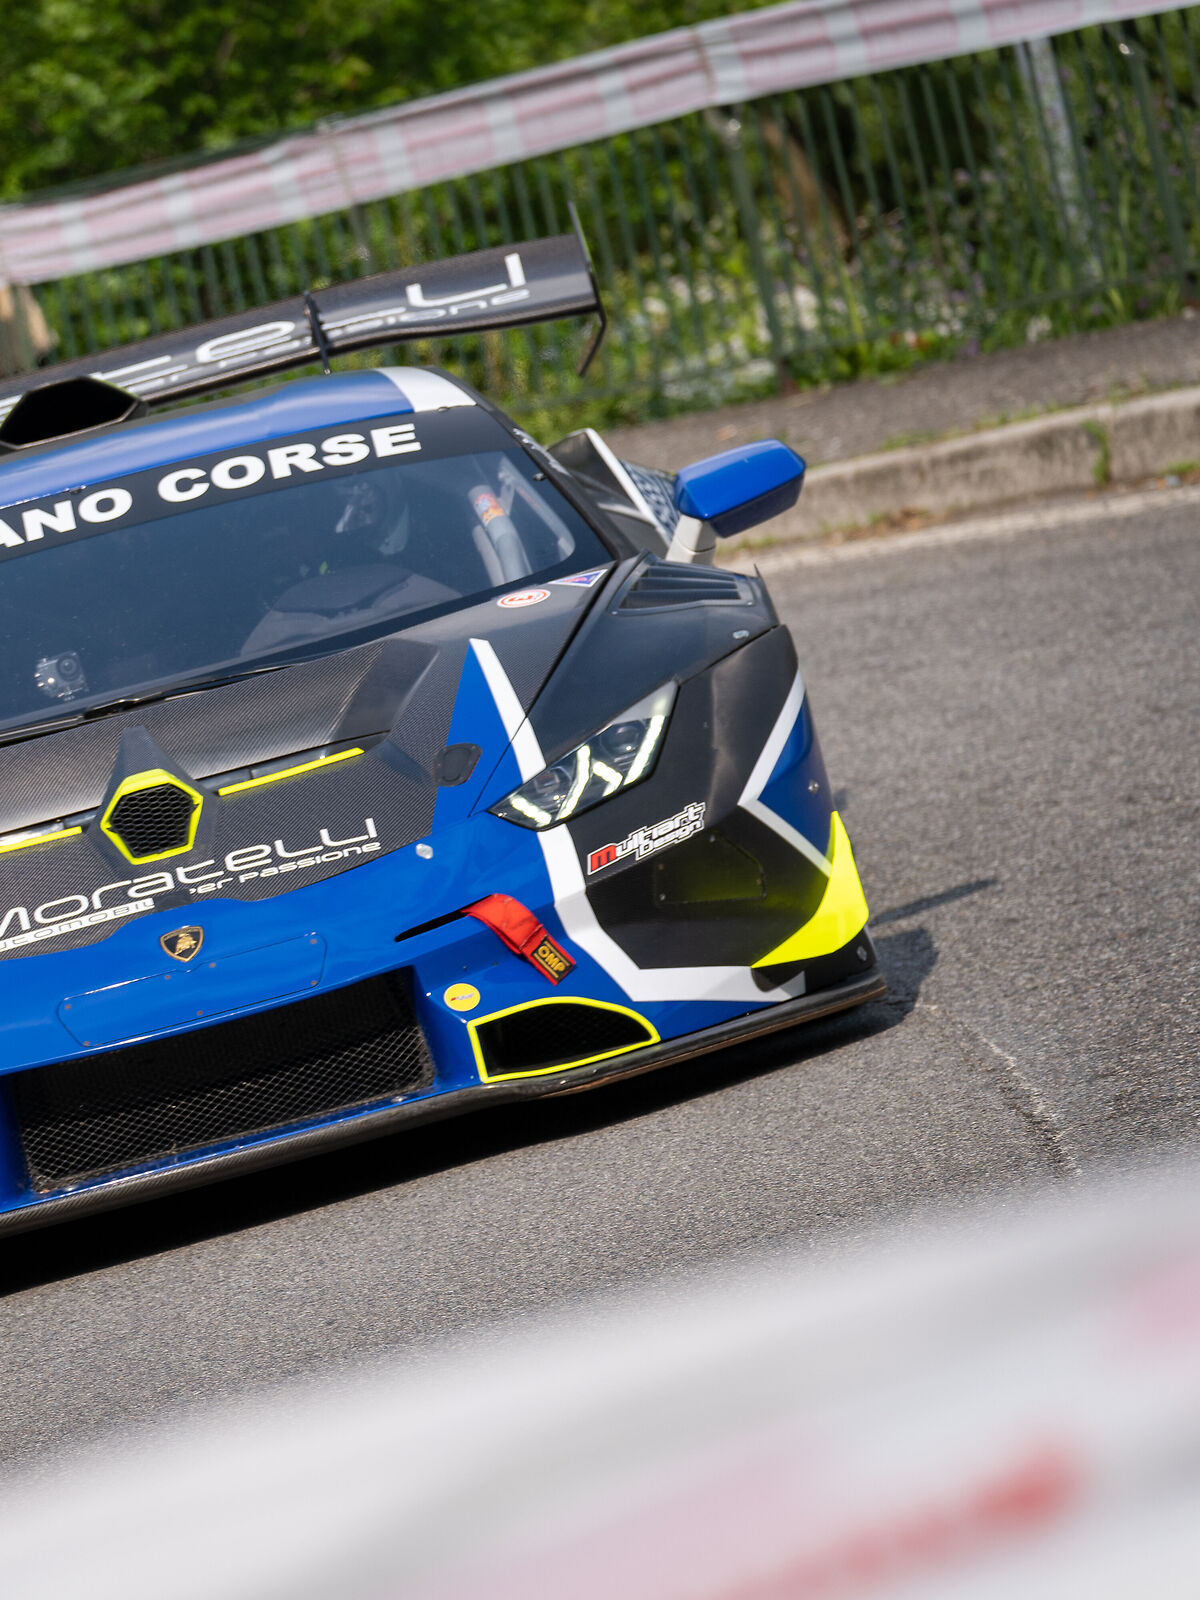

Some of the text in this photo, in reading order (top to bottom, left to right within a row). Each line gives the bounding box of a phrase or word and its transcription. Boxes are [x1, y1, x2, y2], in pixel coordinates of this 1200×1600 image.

[157, 423, 422, 503] CORSE
[638, 819, 703, 858] Design
[189, 877, 234, 895] er
[538, 945, 566, 972] OMP
